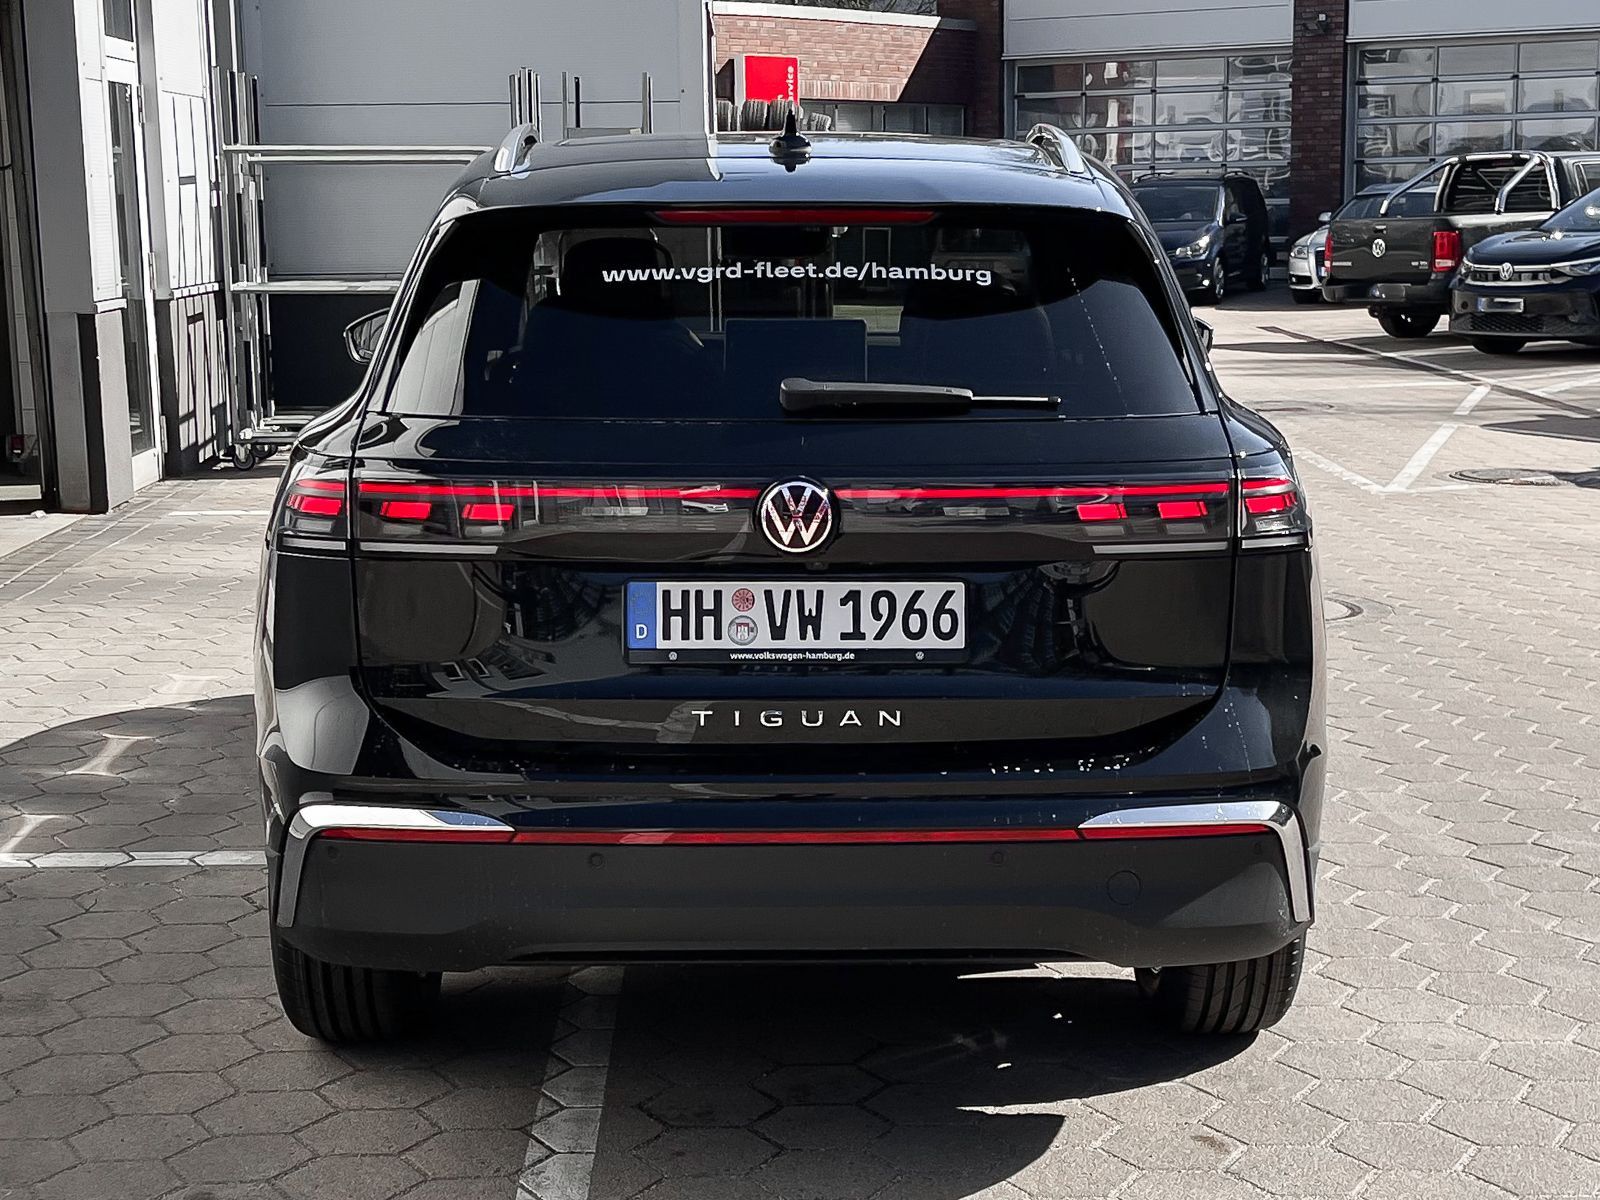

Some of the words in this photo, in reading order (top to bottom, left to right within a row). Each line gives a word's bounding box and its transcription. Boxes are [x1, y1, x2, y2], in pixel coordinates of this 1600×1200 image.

[786, 66, 795, 102] ervice
[602, 261, 992, 286] www.vgrd-fleet.de/hamburg
[760, 481, 833, 553] VW
[662, 589, 723, 641] HH
[763, 589, 825, 641] VW
[838, 589, 958, 641] 1966
[634, 623, 649, 640] D
[729, 651, 856, 662] www.volkswagen-hamburg.de
[691, 710, 902, 727] TIGUAN
